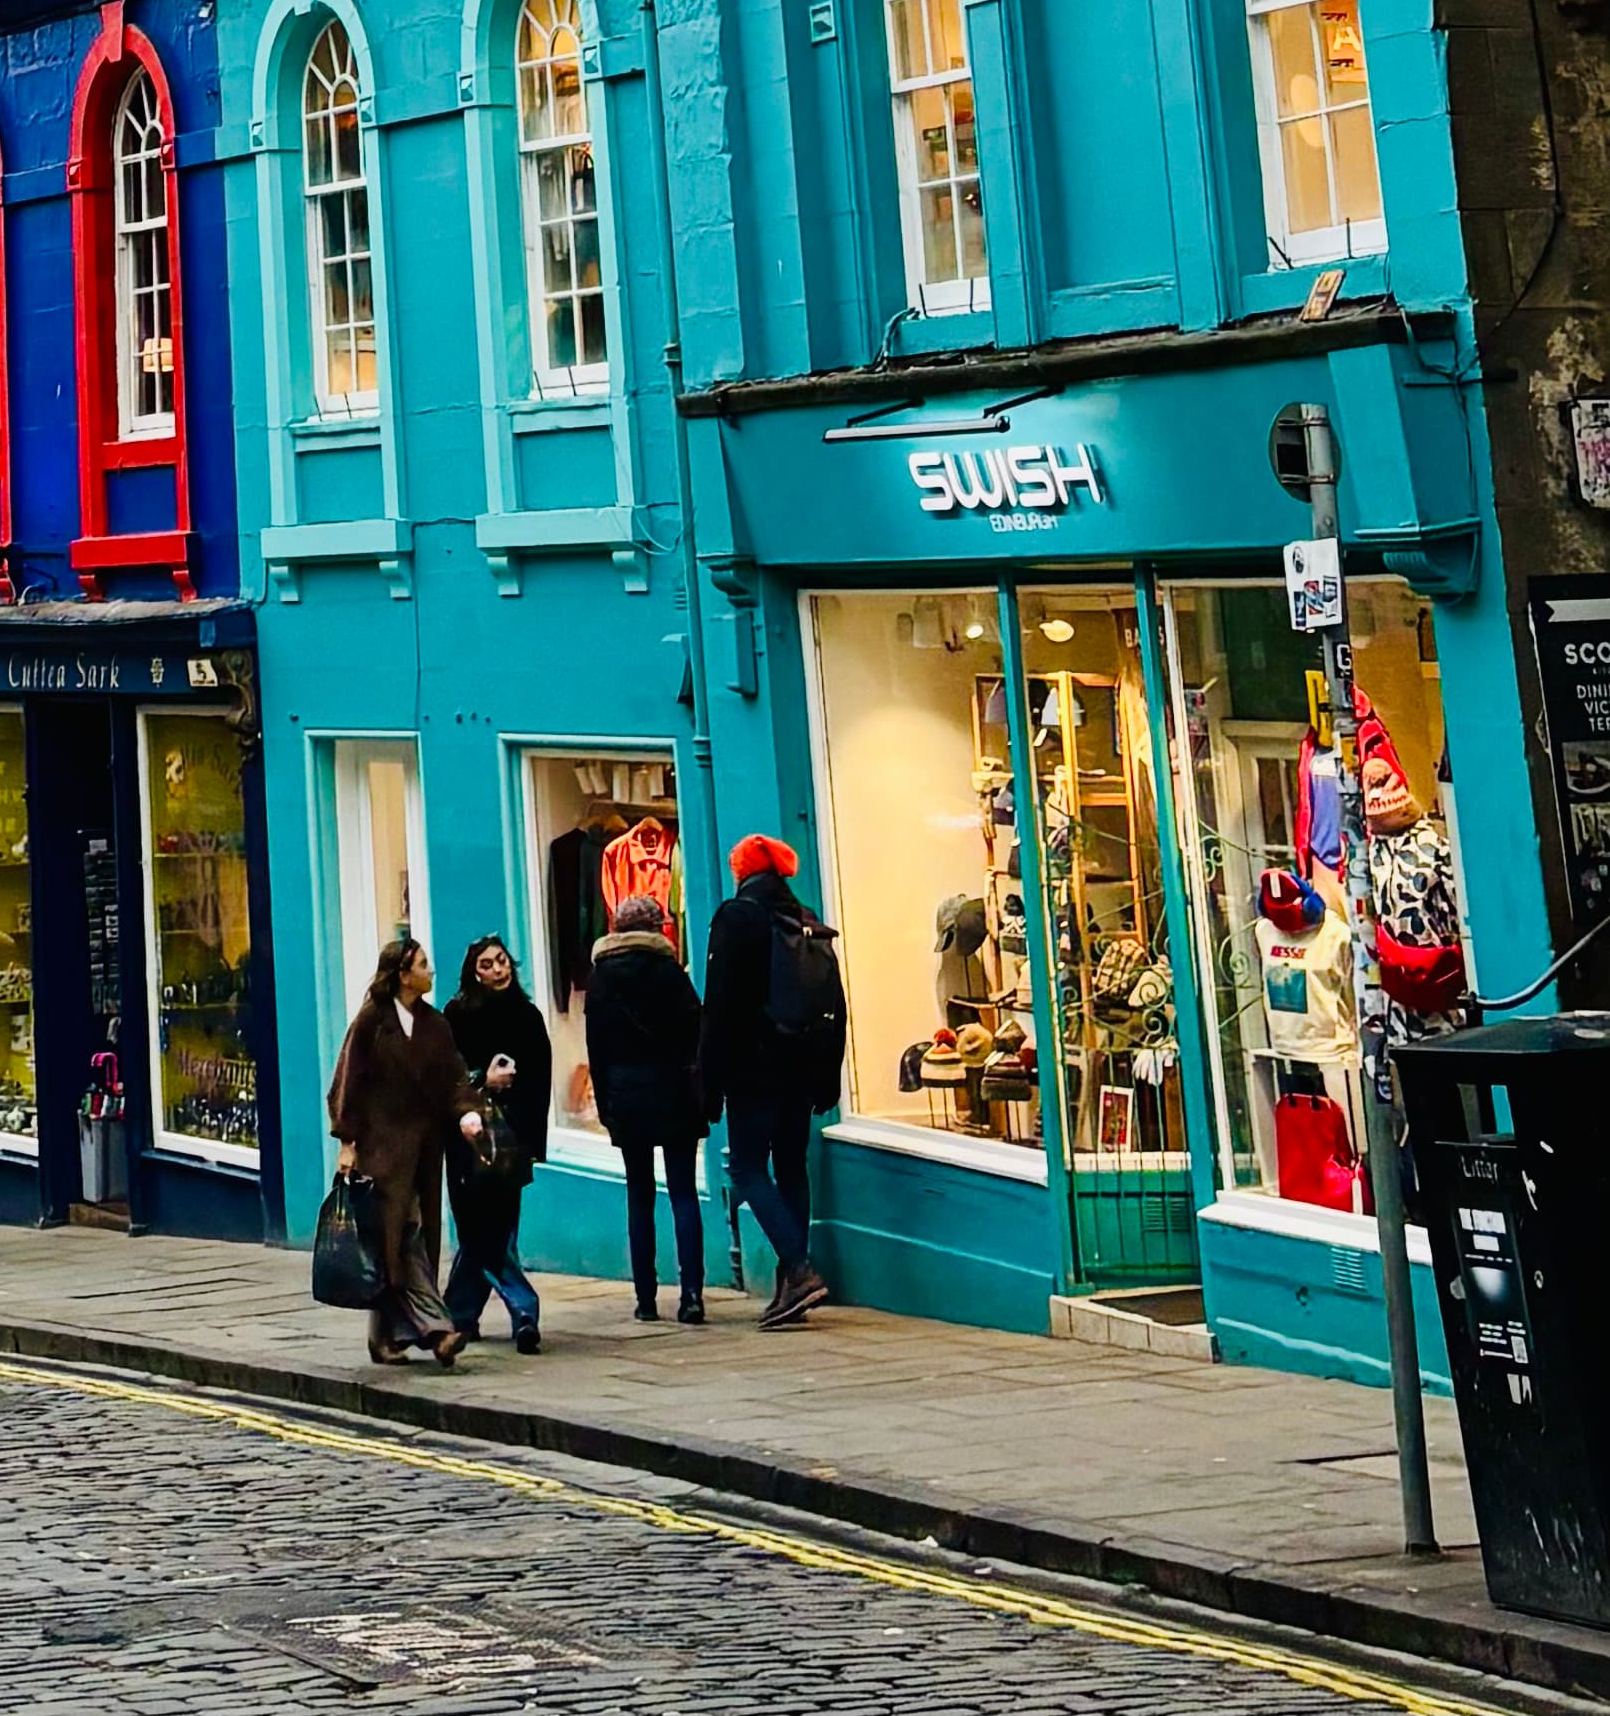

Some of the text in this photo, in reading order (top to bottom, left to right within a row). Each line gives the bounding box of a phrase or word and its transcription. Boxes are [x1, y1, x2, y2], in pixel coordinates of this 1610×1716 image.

[908, 442, 1102, 512] SWISH
[989, 512, 1058, 533] EDINBURGH
[76, 652, 120, 688] Sark
[1461, 1156, 1499, 1184] Litter
